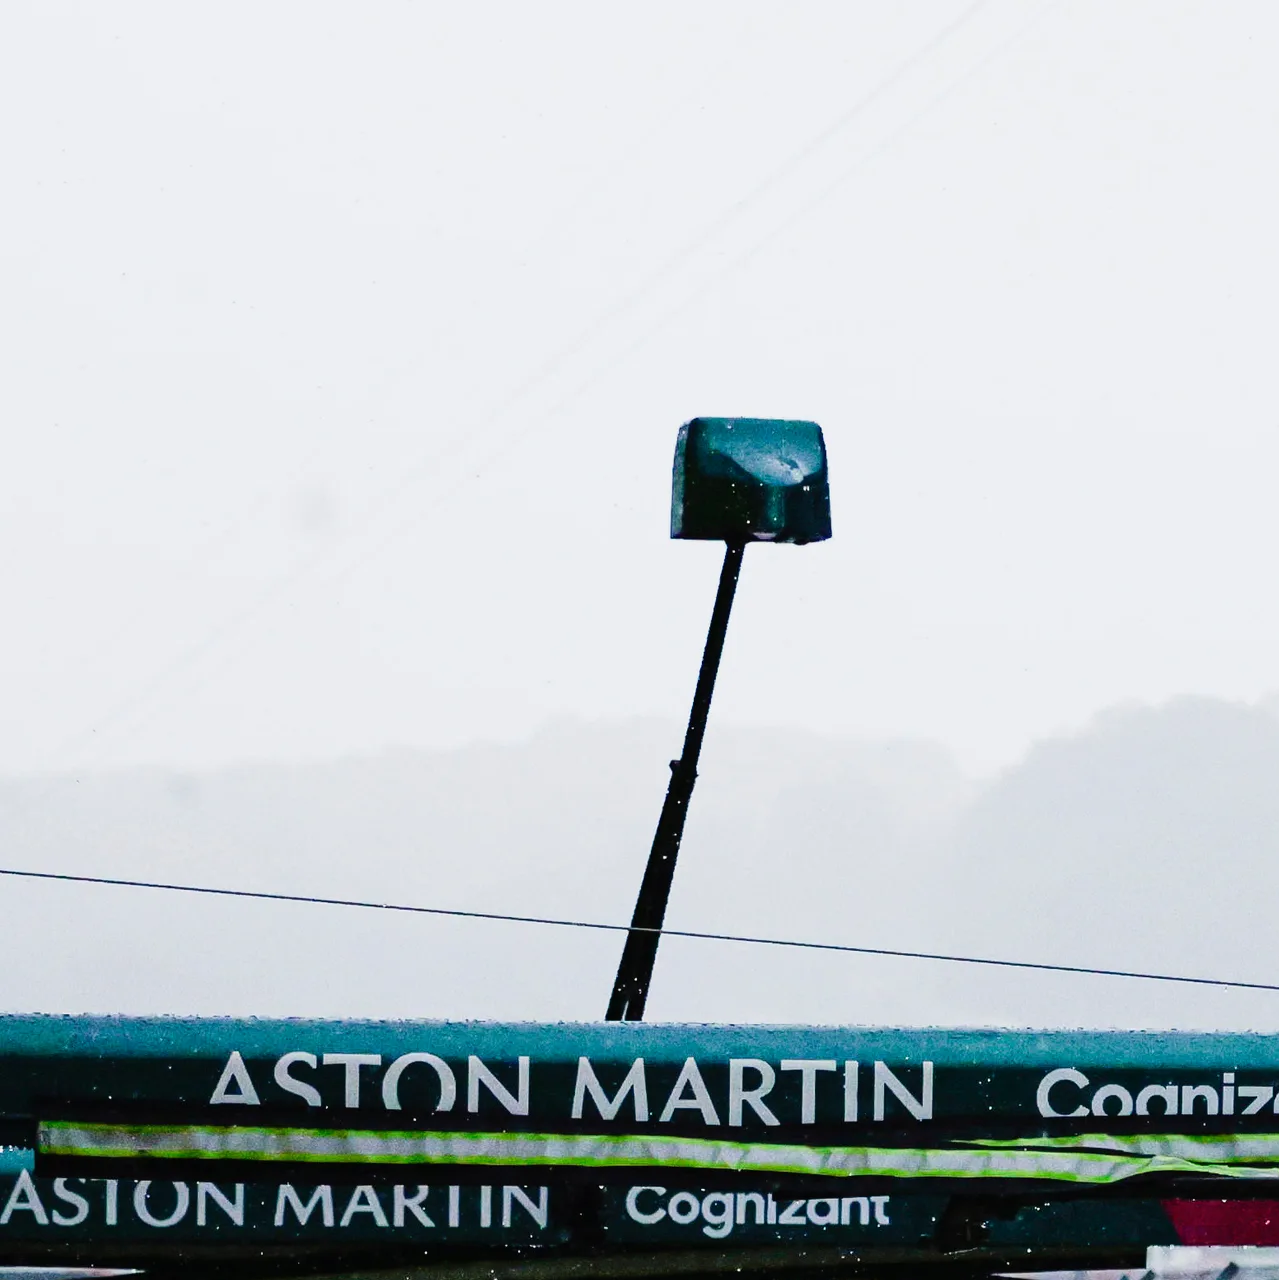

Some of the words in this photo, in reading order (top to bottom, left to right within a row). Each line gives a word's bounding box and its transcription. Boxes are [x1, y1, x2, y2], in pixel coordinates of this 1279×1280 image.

[210, 1050, 529, 1116] ASTON
[571, 1055, 934, 1127] MARTIN
[0, 1168, 244, 1228] ASTON
[274, 1183, 548, 1229] MARTIN
[625, 1185, 890, 1239] Cognizant
